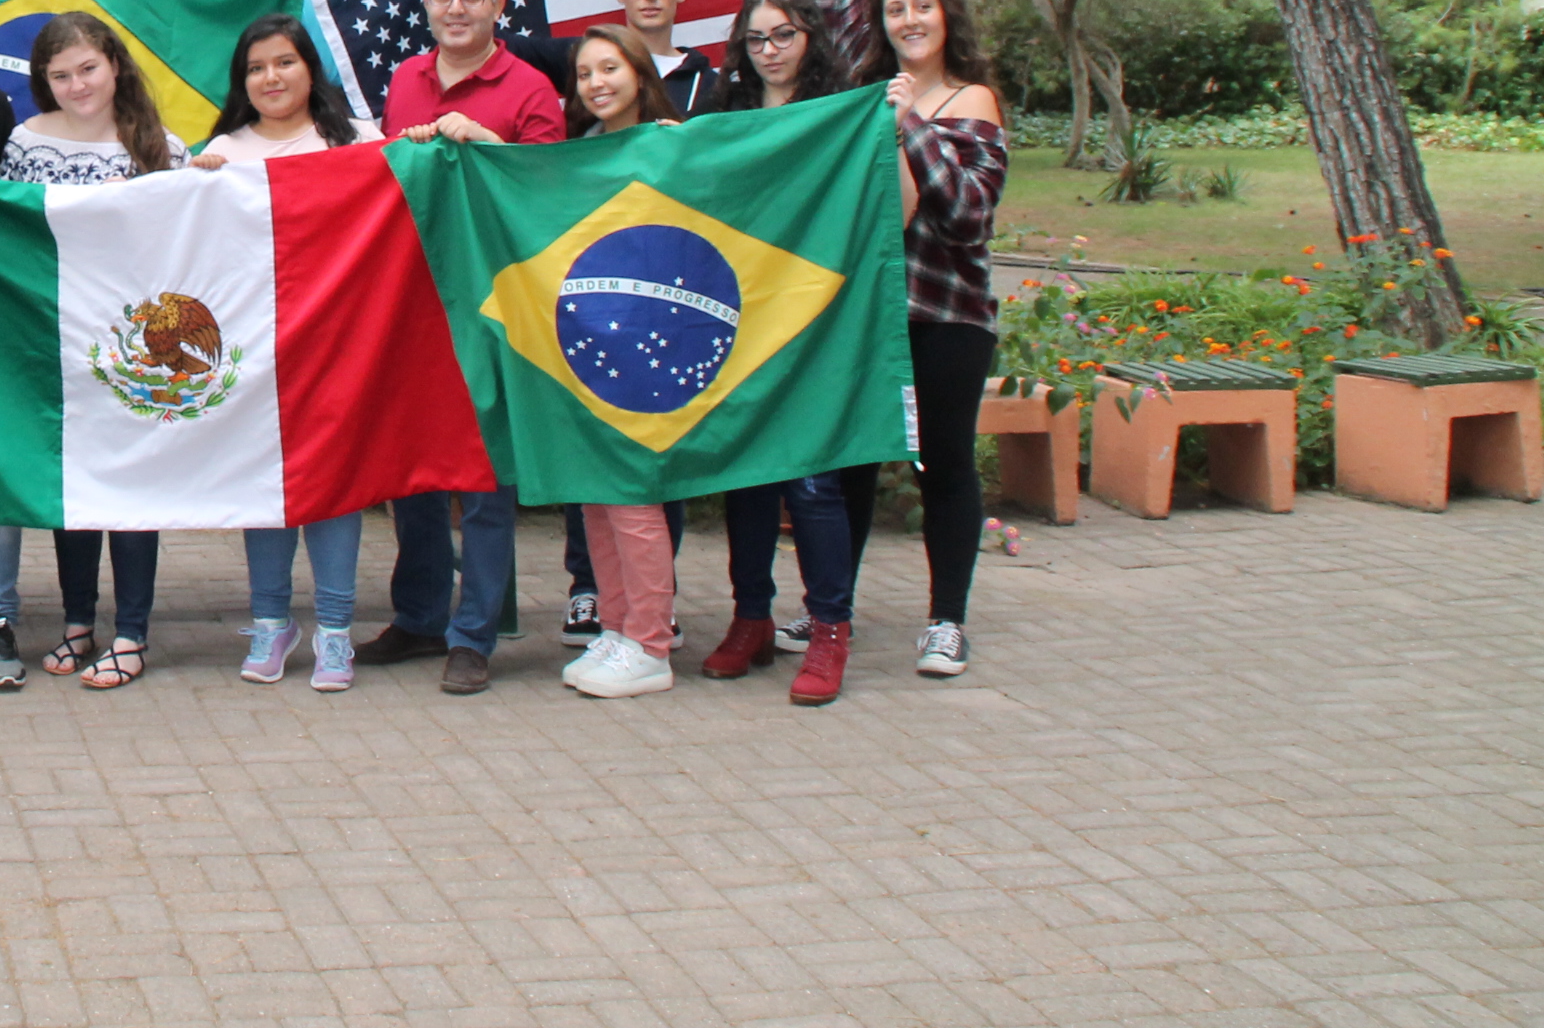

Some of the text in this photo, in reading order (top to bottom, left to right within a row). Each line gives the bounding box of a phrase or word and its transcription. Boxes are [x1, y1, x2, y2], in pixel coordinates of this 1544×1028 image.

[564, 280, 737, 323] ORDEM E PROGRESSO
